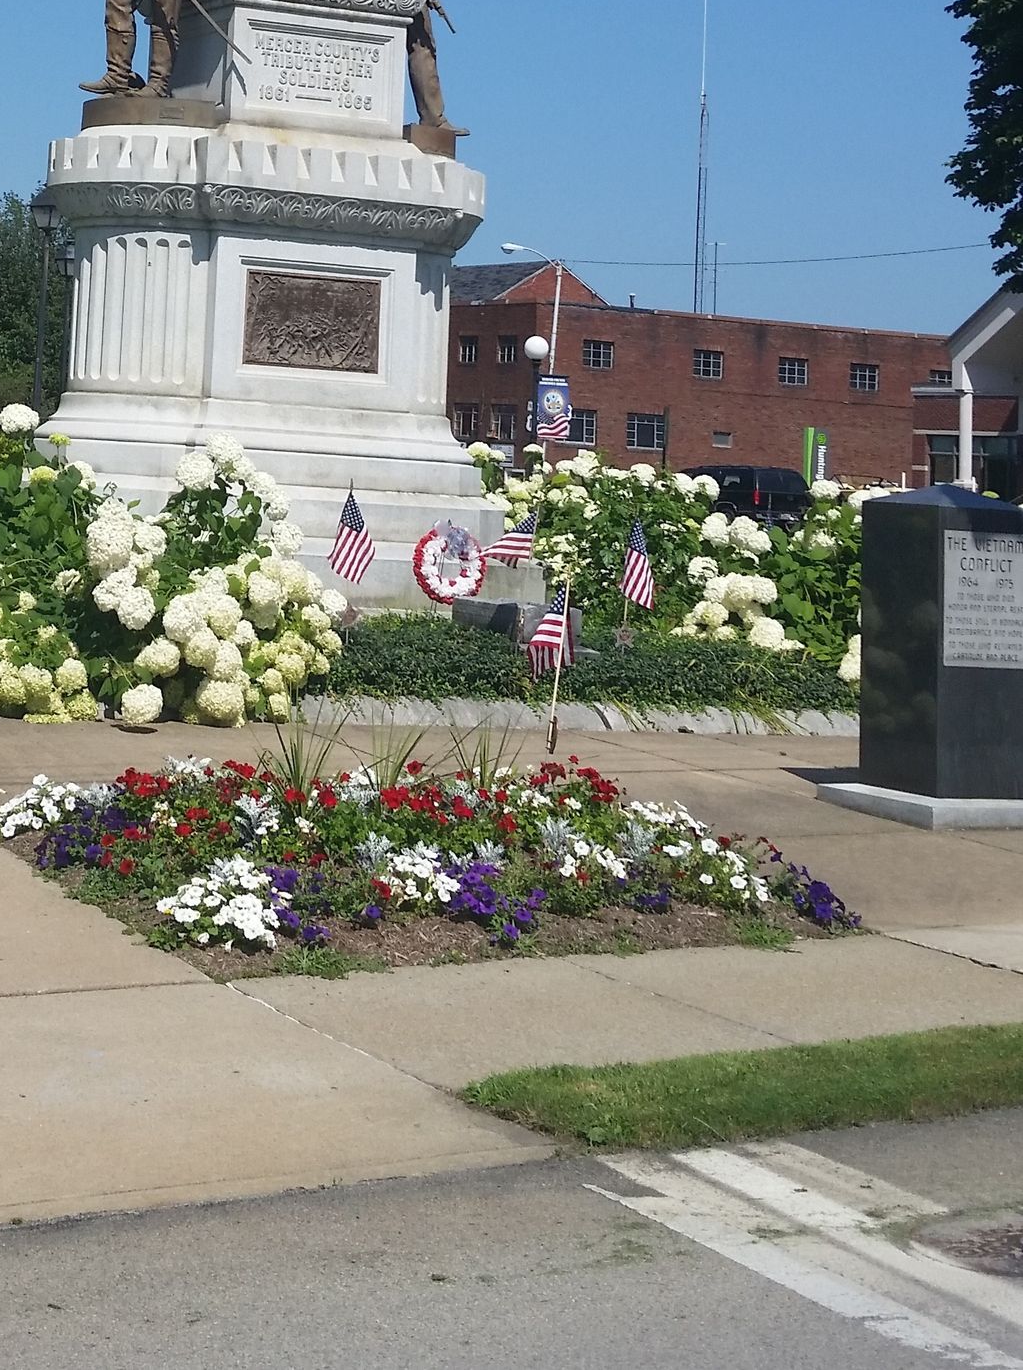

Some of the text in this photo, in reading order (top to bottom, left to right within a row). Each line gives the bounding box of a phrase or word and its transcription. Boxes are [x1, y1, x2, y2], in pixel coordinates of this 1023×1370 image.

[255, 33, 379, 63] MERCER COUNTY'S
[261, 51, 373, 79] TRIBUTE TO HER
[279, 70, 354, 93] SOLDIERS.
[259, 84, 290, 102] 1861
[338, 93, 372, 111] 1865
[948, 537, 1023, 553] THE VIETNAM
[961, 557, 1012, 572] CONFLICT
[958, 576, 1014, 589] 1964 1975
